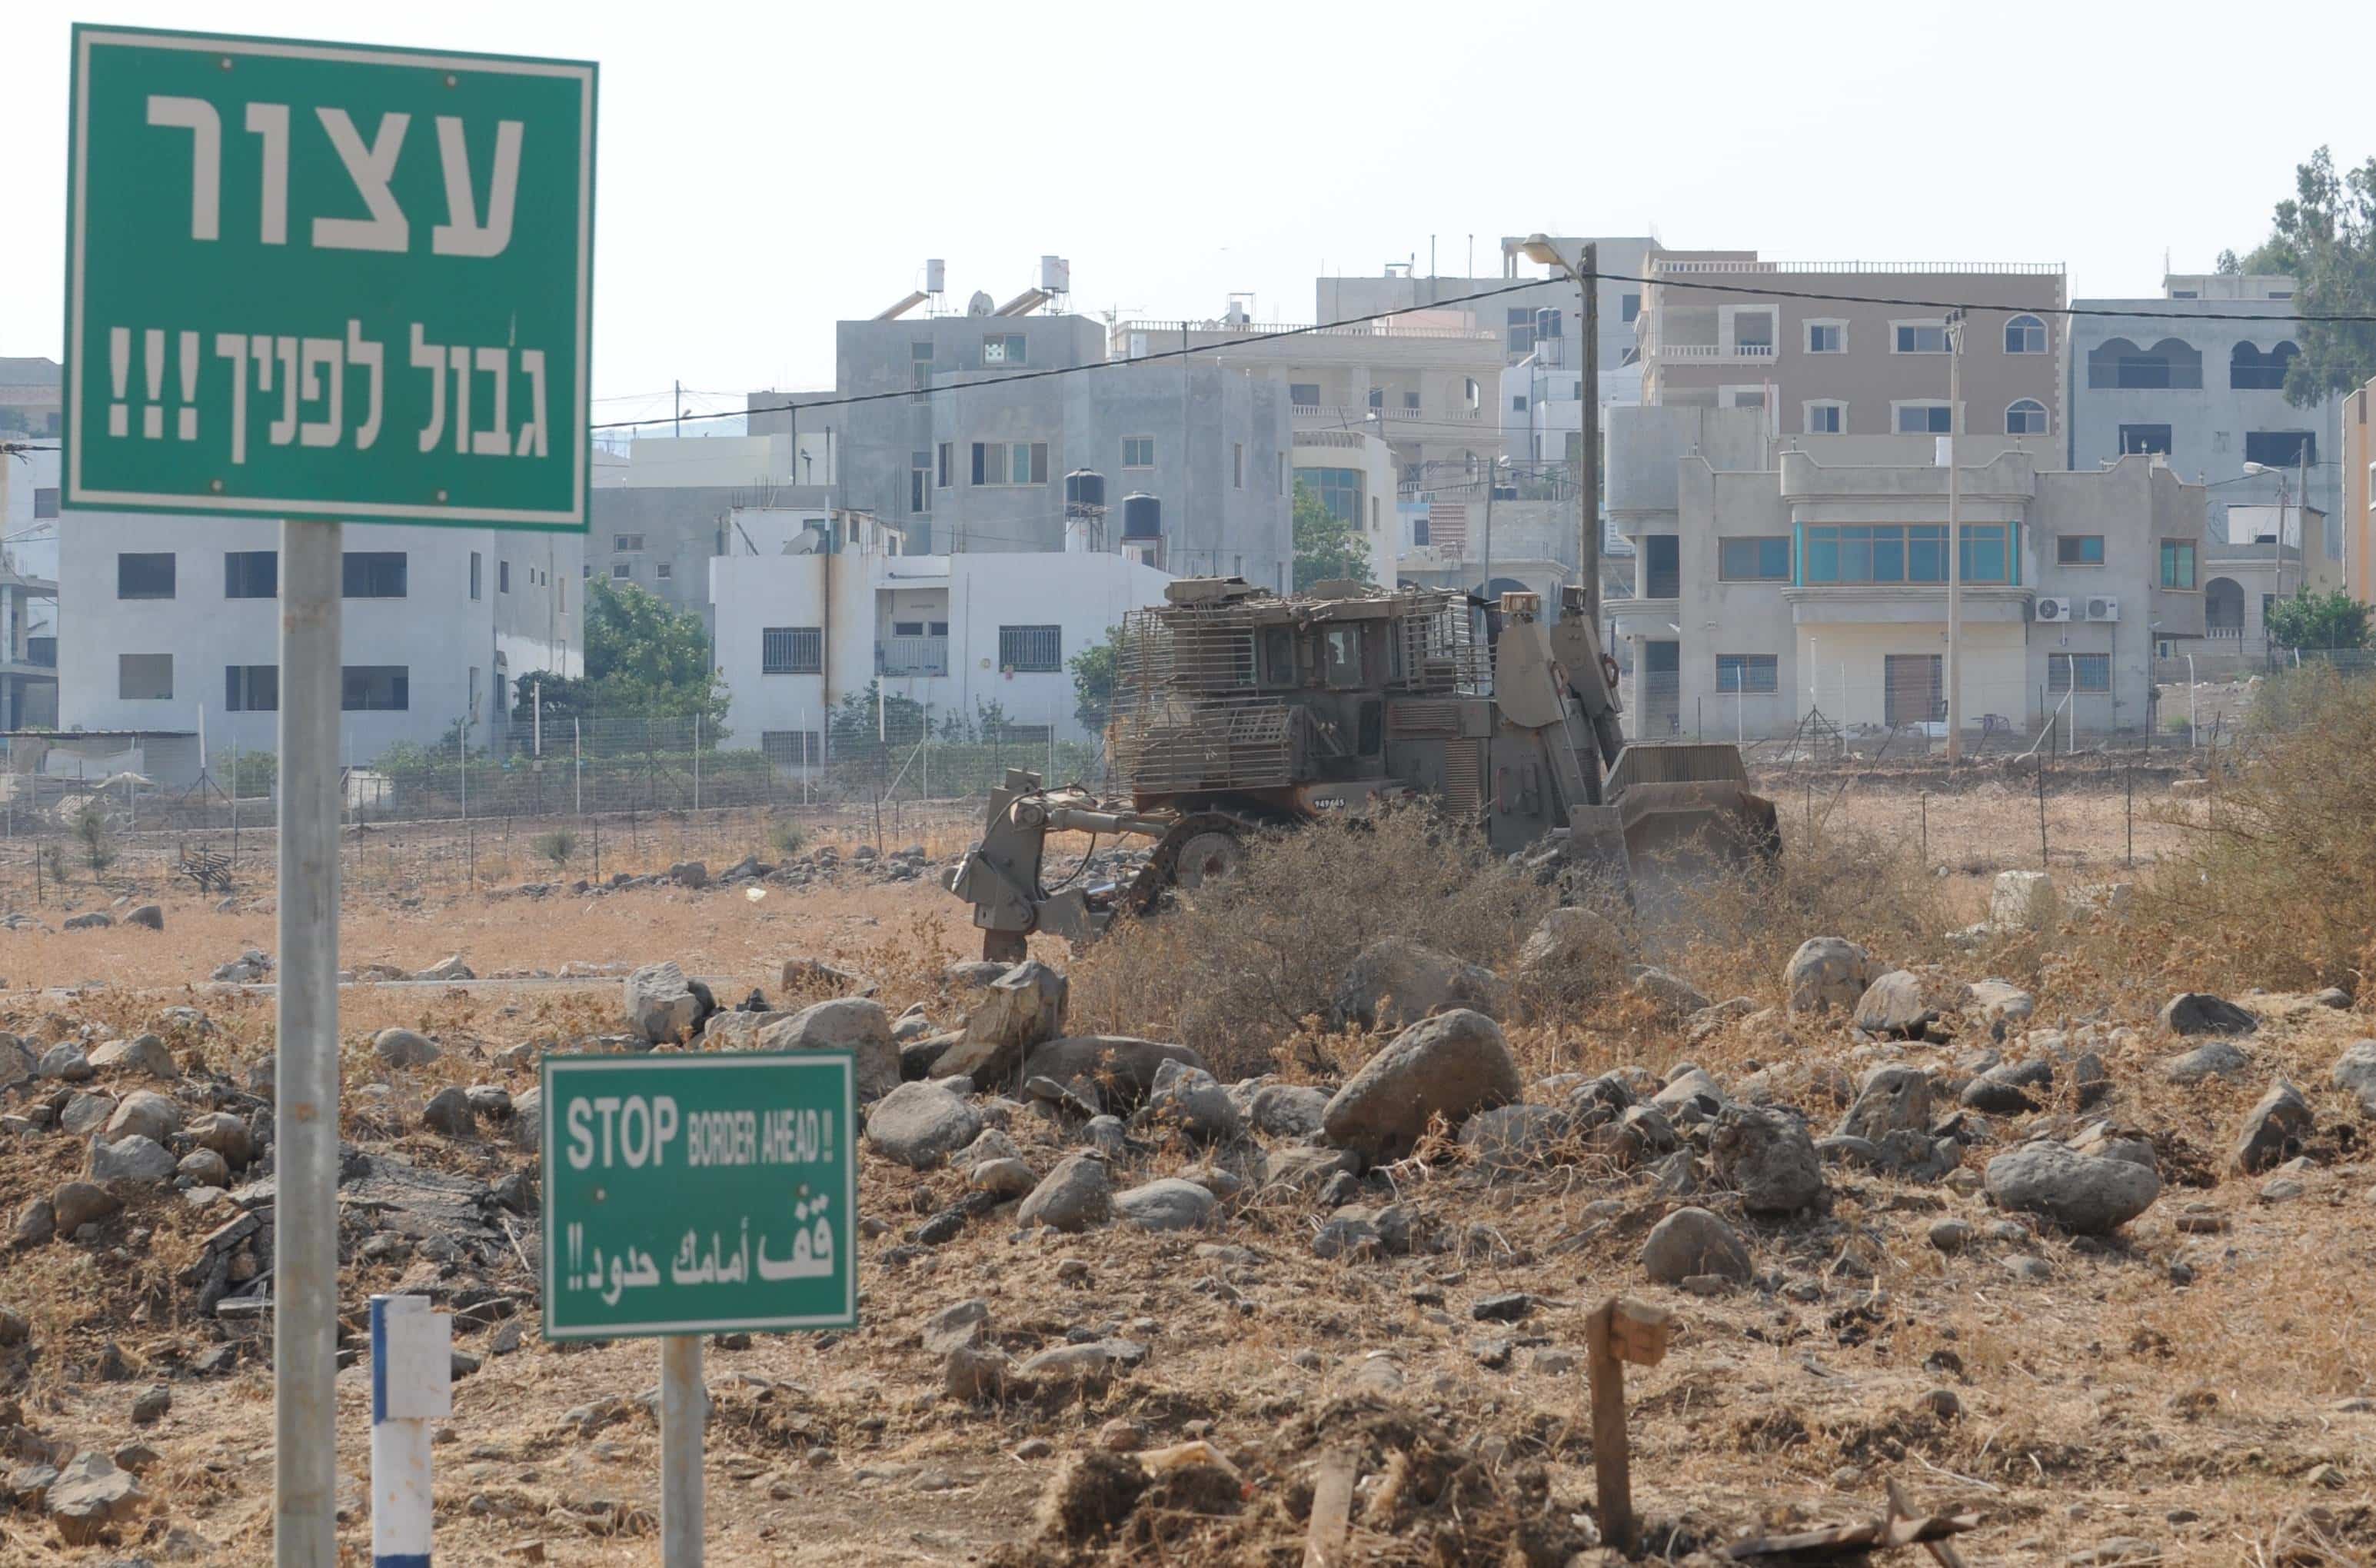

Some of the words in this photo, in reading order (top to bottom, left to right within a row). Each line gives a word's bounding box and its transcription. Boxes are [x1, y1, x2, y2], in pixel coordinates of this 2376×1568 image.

[147, 95, 524, 257] עצור
[411, 323, 547, 457] גבול
[567, 1096, 678, 1169] STOP
[688, 1110, 757, 1166] BORDER
[671, 1217, 750, 1283] أمامك
[757, 1193, 834, 1280] قف
